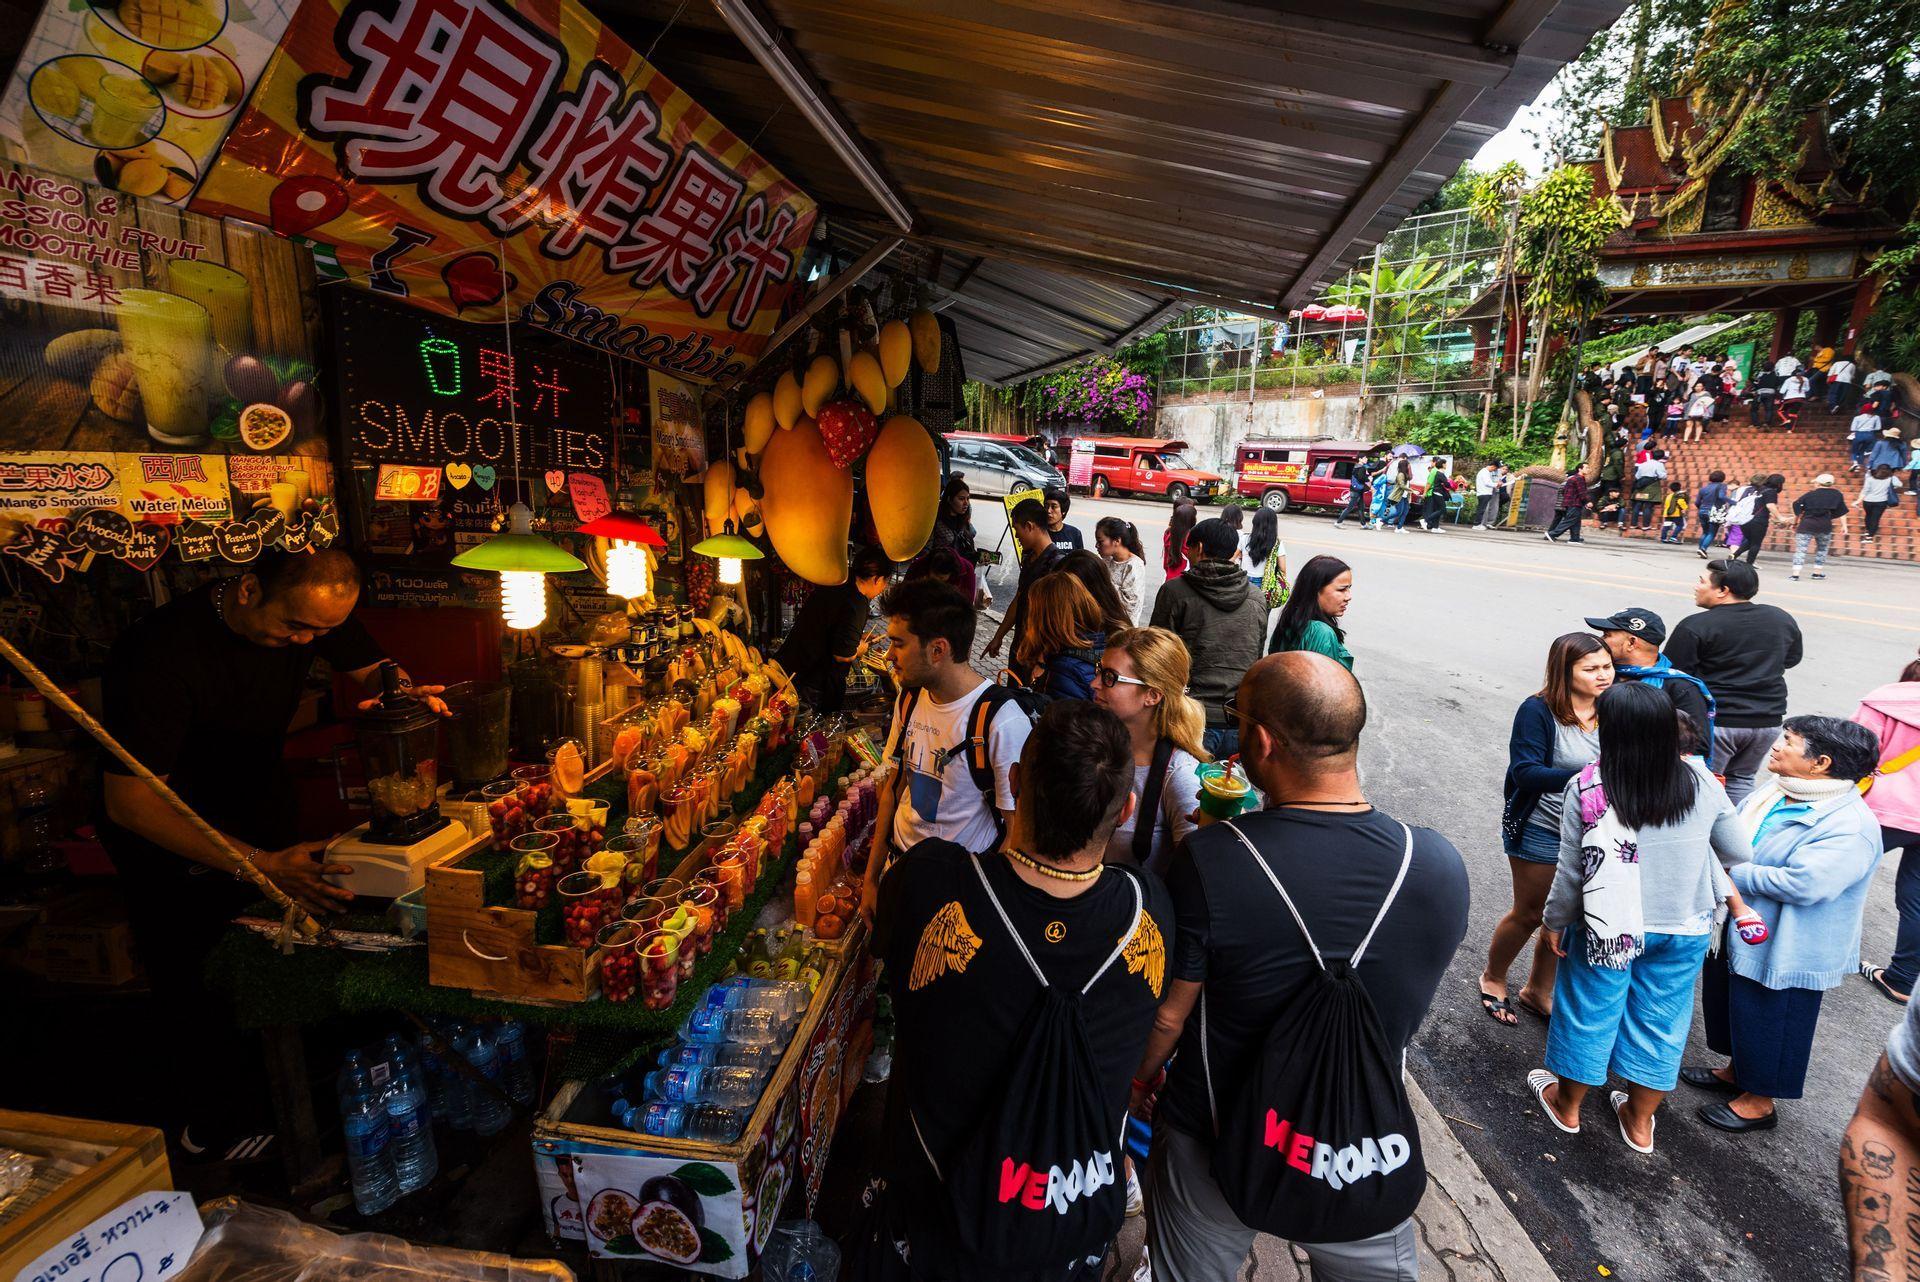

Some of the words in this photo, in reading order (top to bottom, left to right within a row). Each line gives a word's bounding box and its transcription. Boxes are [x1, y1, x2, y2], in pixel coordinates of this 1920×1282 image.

[95, 196, 119, 217] &
[0, 199, 110, 240] SSION
[120, 226, 206, 260] FRUIT
[521, 279, 747, 383] Smoothie
[477, 348, 570, 418] 果汁
[359, 400, 604, 469] SMOOTHIES
[230, 456, 261, 464] MANGO
[230, 464, 269, 472] PASSION
[271, 464, 295, 472] FRUIT
[0, 464, 111, 490] 芒果冰沙
[140, 455, 208, 483] 西瓜
[230, 472, 278, 480] SMOOTHIE
[0, 496, 47, 510] Mango
[50, 494, 118, 508] Smoothies
[130, 499, 177, 512] Water
[181, 497, 225, 511] Melon
[79, 516, 135, 545] Avocado
[224, 532, 257, 544] Passion
[132, 533, 157, 545] Mix
[182, 534, 214, 545] Dragon
[125, 544, 157, 558] fruit
[188, 544, 212, 555] fruit
[1264, 1107, 1412, 1191] WEROAD
